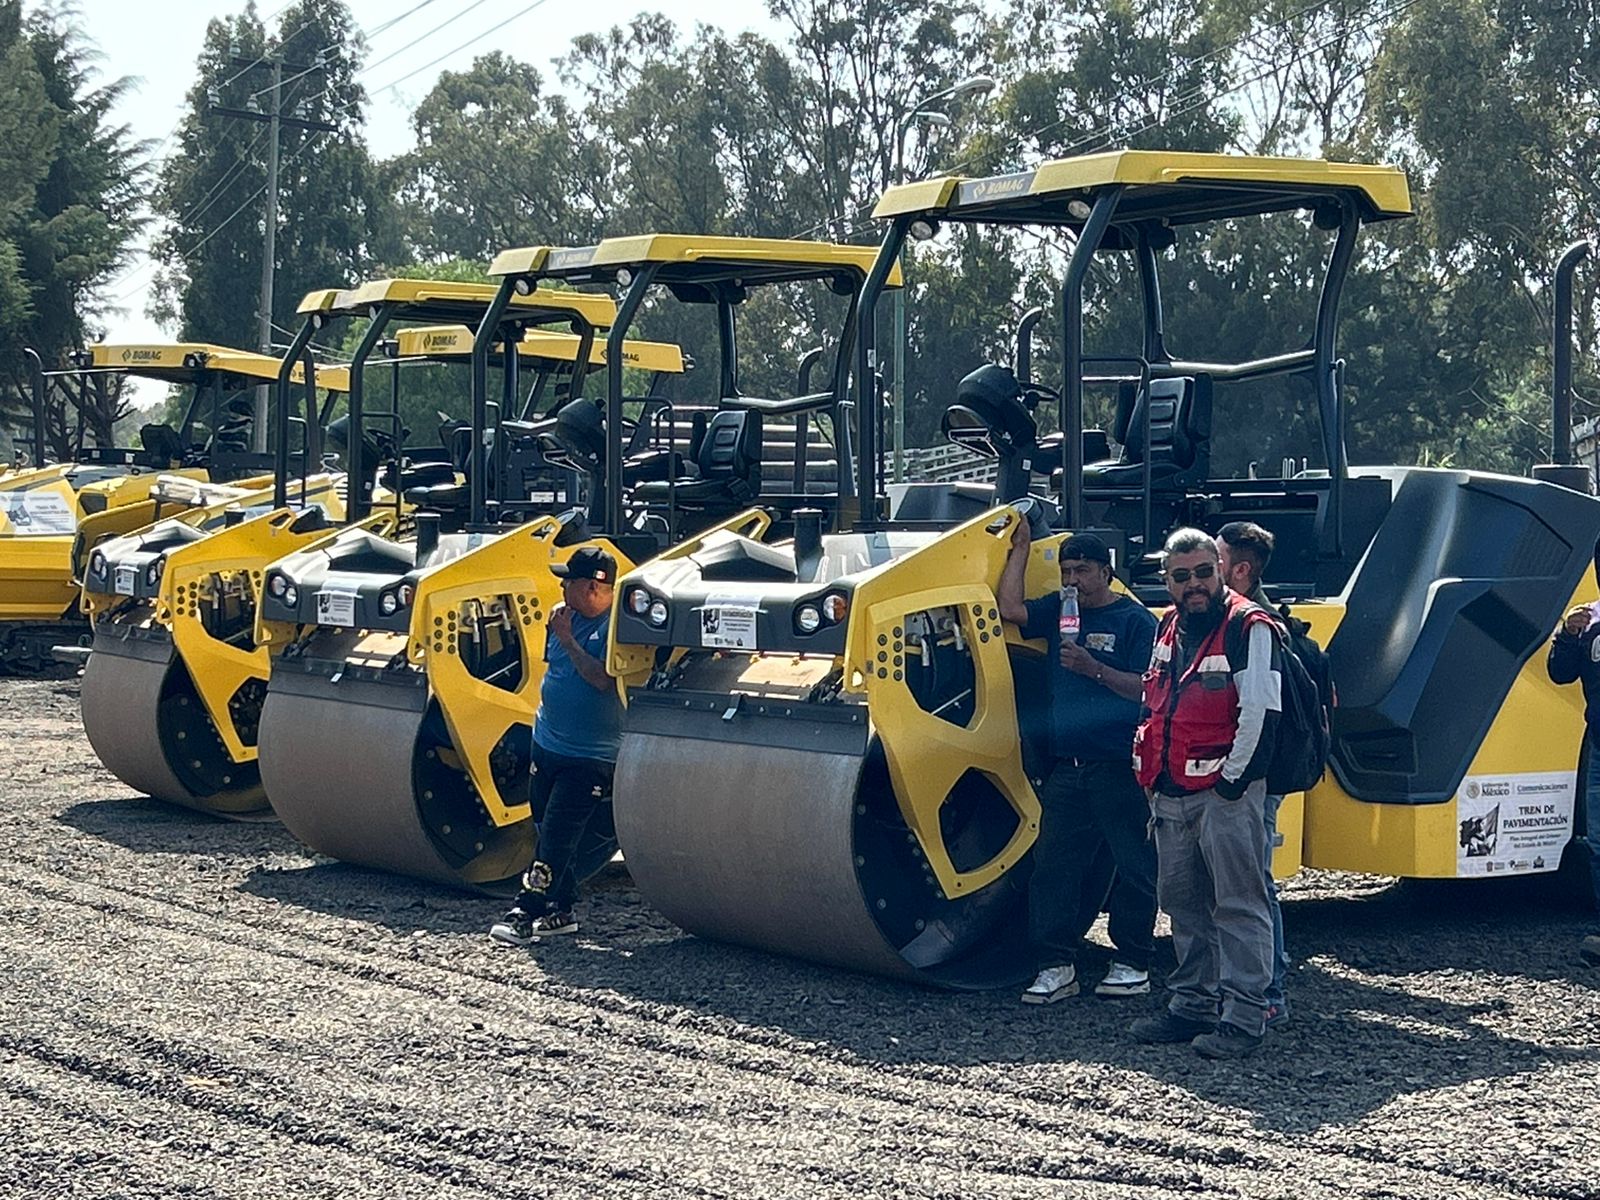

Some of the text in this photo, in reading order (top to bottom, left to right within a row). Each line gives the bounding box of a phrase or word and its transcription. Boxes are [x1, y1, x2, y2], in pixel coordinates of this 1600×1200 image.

[986, 178, 1025, 195] BOMAG
[432, 335, 458, 346] BOMAG
[132, 350, 162, 360] BOMAG
[1482, 787, 1509, 796] México
[1517, 783, 1568, 791] Comunicaciones
[1518, 805, 1555, 815] TREN DE
[1503, 814, 1567, 828] PAVIMENTACIÓN
